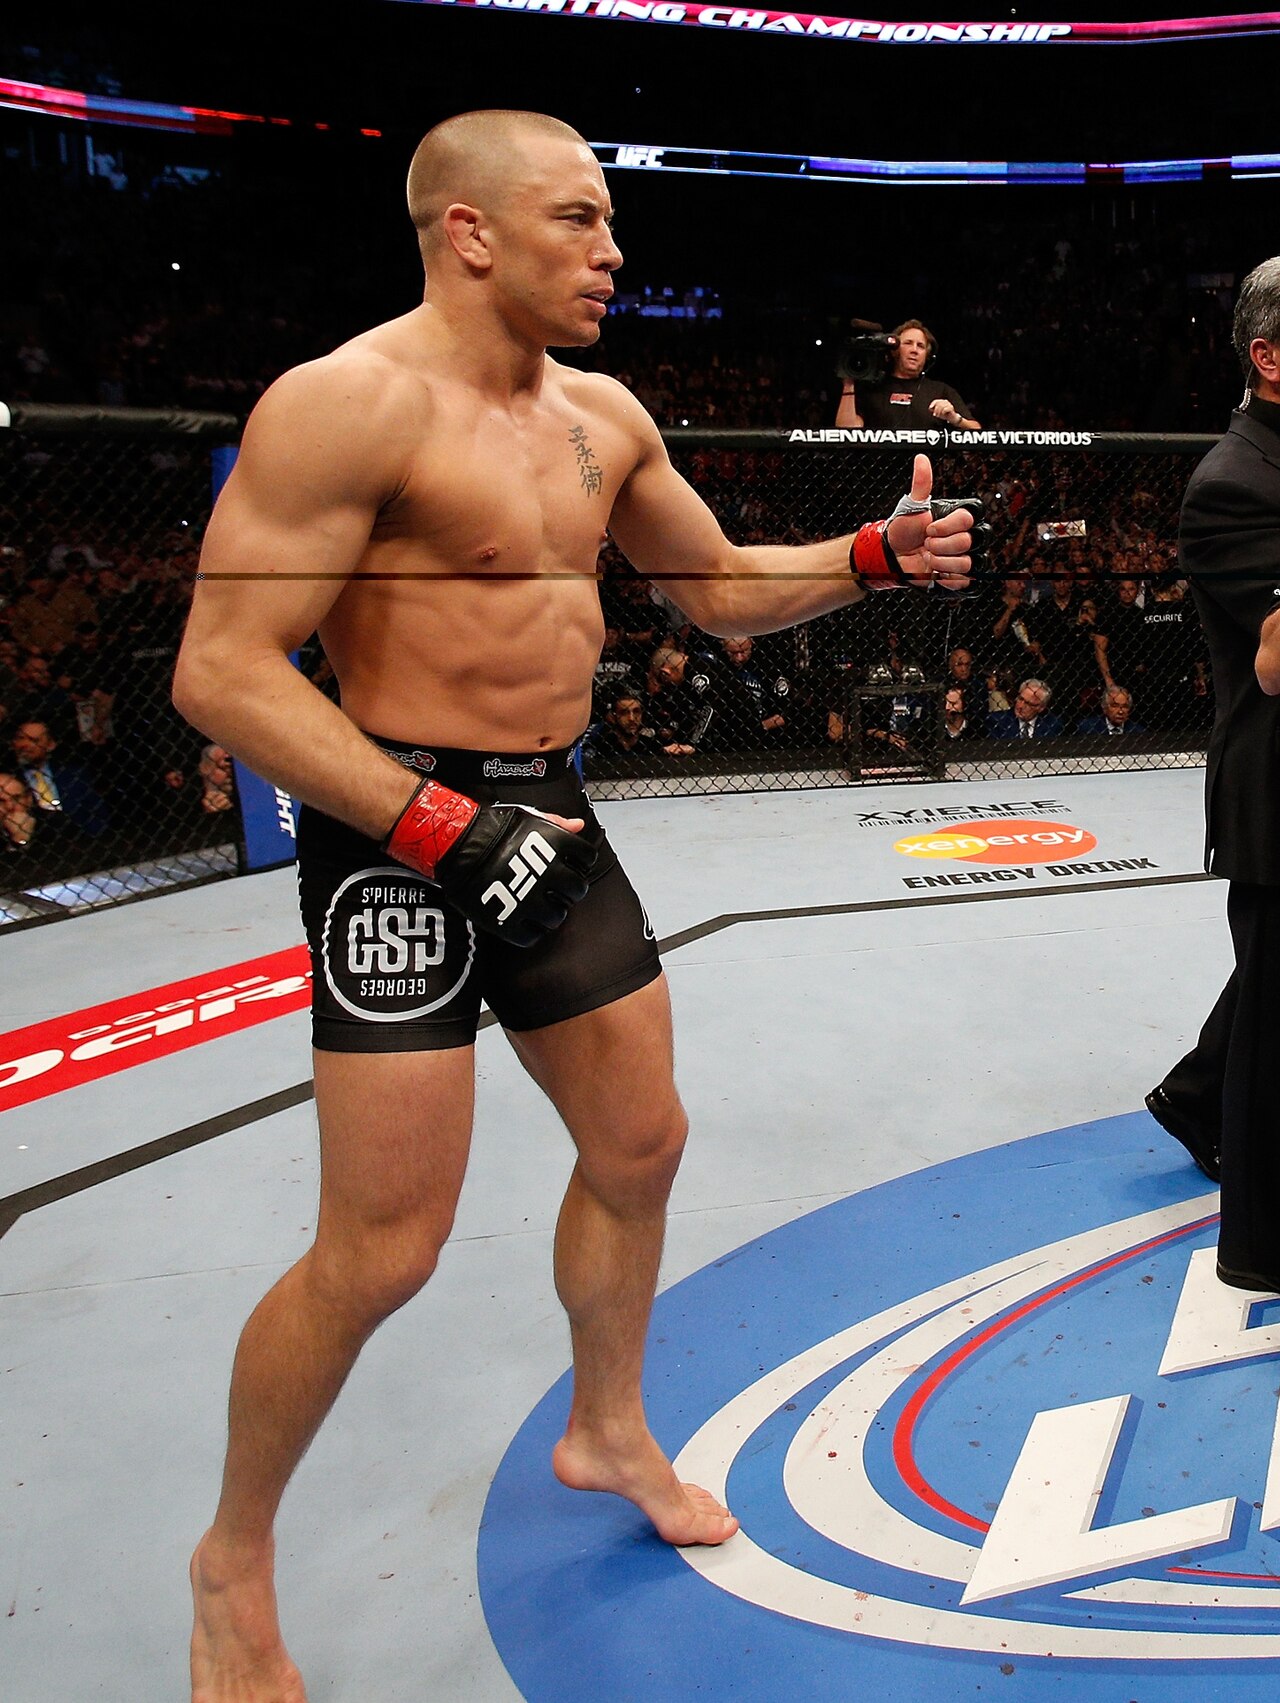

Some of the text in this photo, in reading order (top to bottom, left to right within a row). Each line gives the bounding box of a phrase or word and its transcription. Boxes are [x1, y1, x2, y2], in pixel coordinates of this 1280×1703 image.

[442, 0, 1071, 42] HTING CHAMPIONSHIP
[616, 147, 664, 167] UFC
[788, 429, 1092, 446] ALIENWARE GAME VICTORIOUS
[854, 799, 1061, 822] XYIENCE
[897, 828, 1084, 853] xenergy
[481, 830, 557, 922] UFC
[901, 857, 1160, 890] ENERGY DRINK
[360, 978, 426, 997] GEORGES
[68, 975, 271, 1041] DODGE
